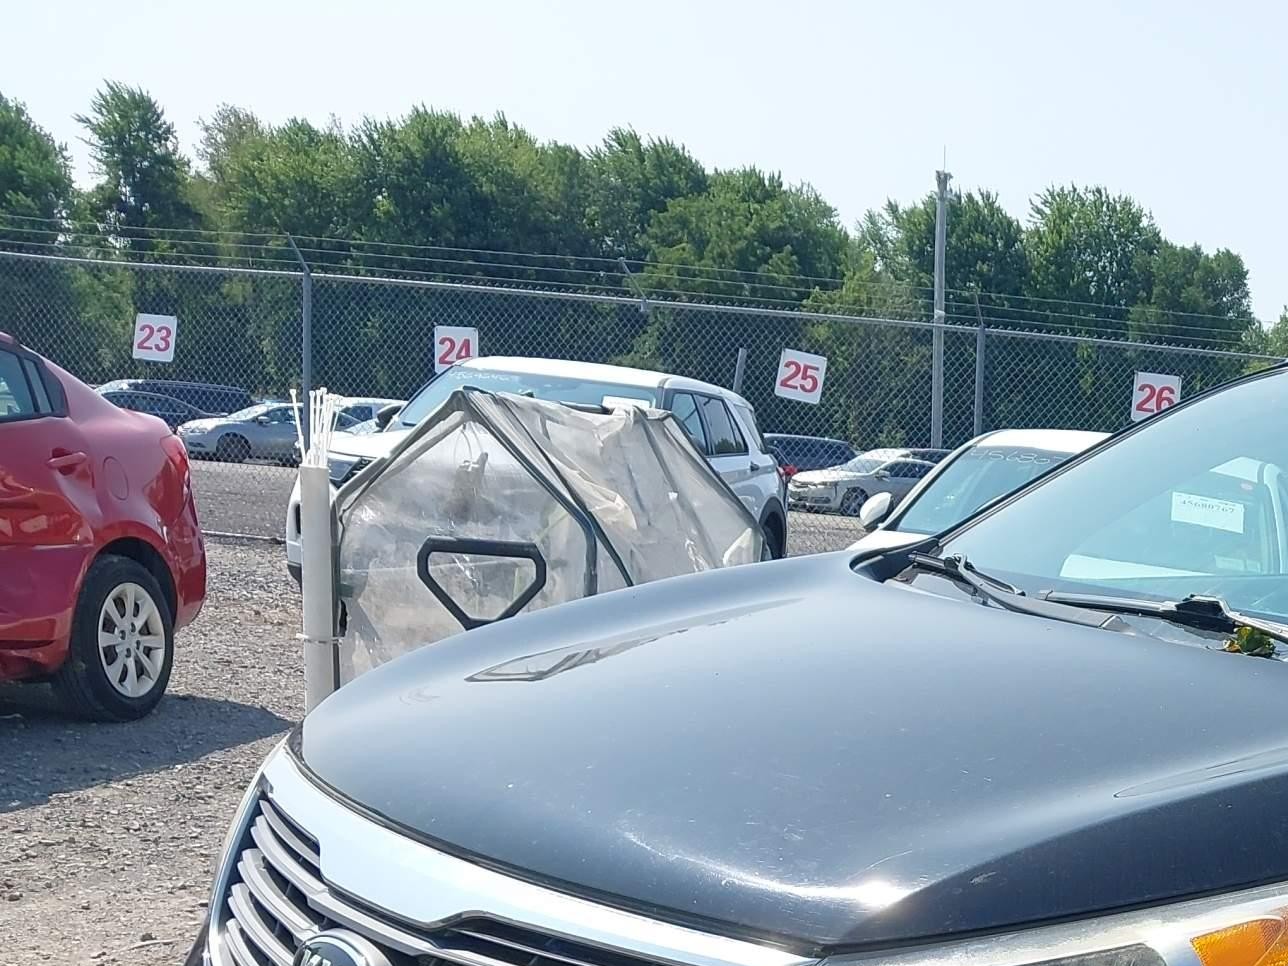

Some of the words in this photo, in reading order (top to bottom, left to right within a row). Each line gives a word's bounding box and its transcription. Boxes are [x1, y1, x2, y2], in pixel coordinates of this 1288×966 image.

[137, 324, 171, 351] 23
[439, 337, 472, 365] 24
[780, 361, 819, 392] 25
[1136, 384, 1175, 412] 26
